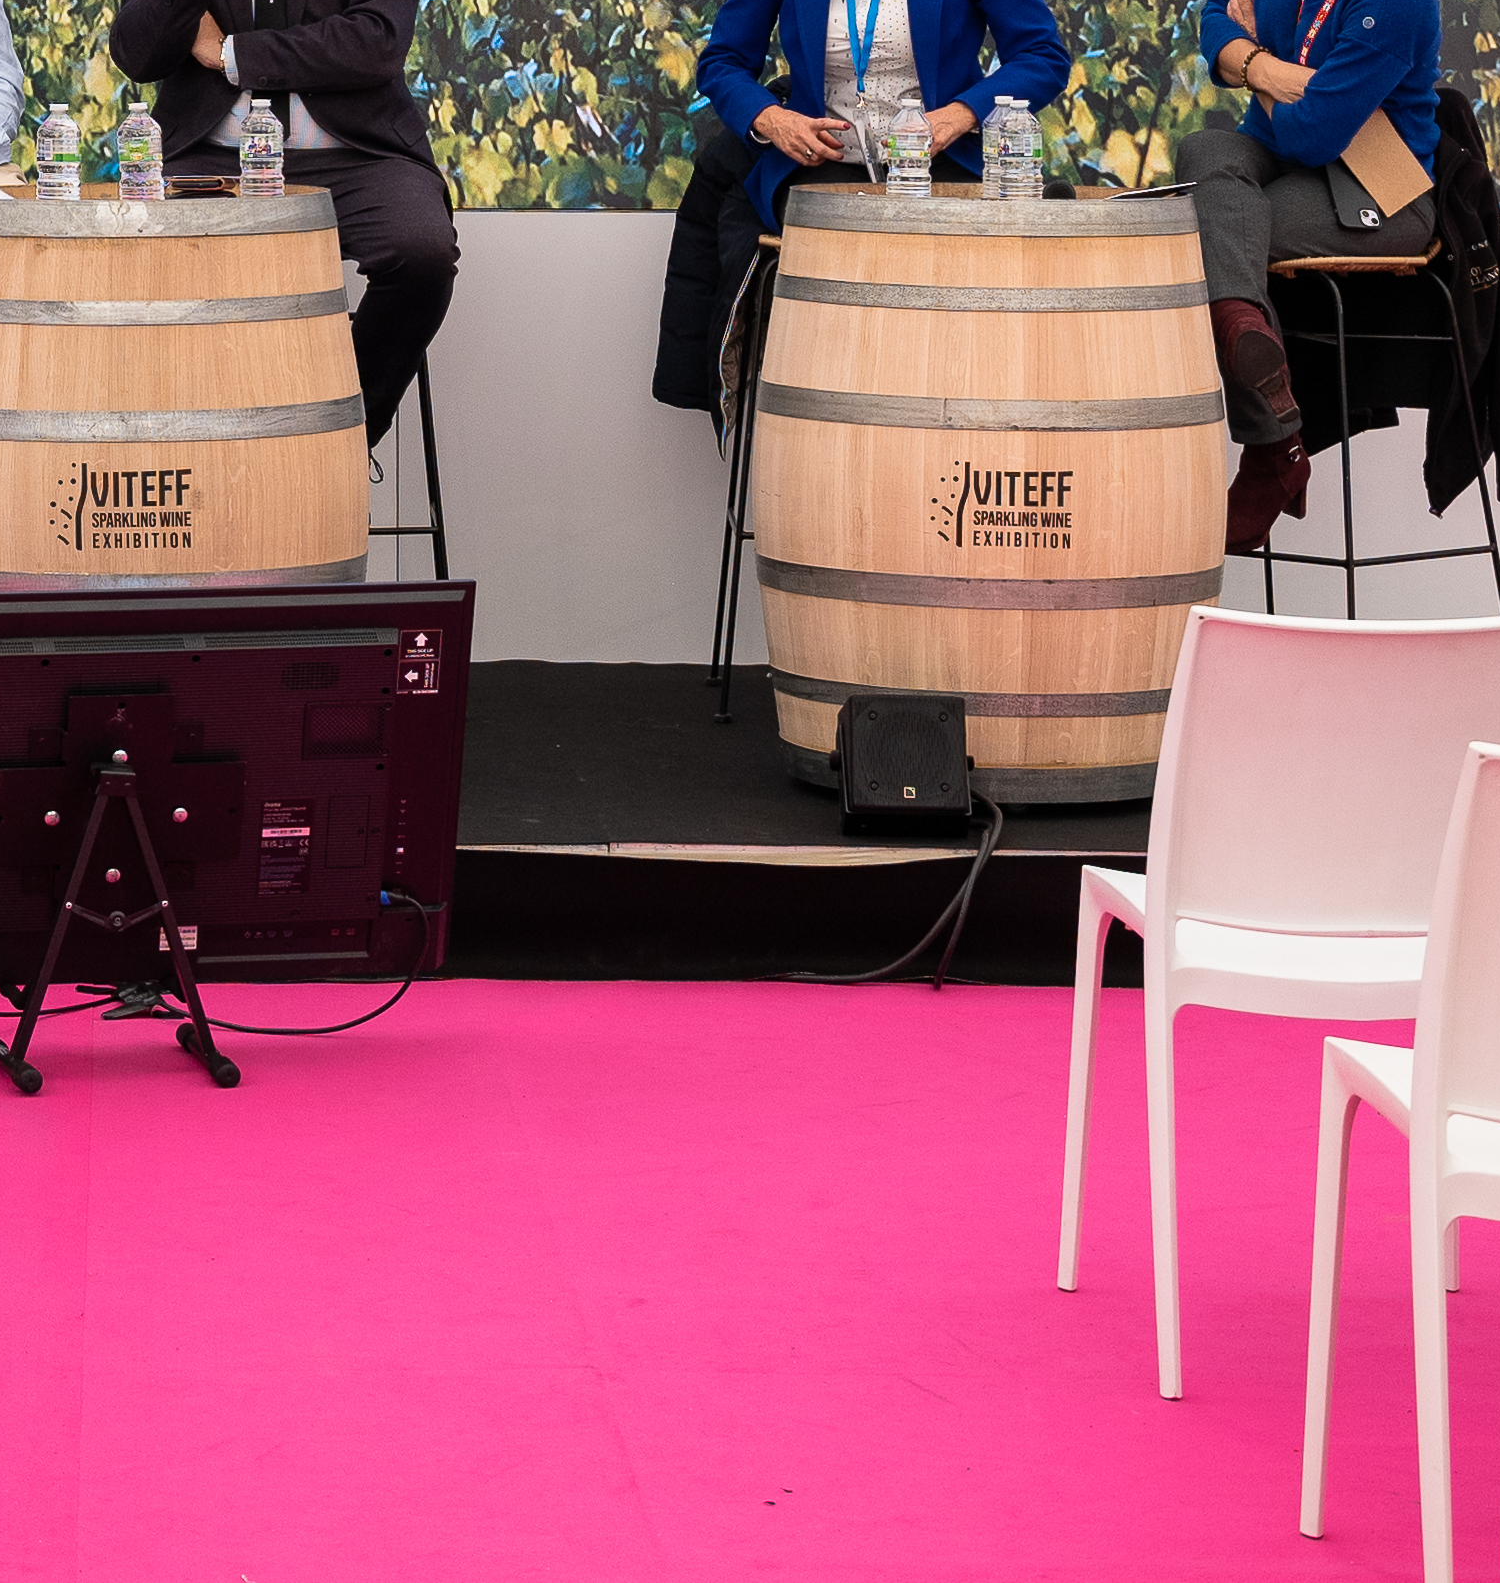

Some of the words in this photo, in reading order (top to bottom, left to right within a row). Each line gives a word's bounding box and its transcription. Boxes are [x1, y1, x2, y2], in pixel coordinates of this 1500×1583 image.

[91, 469, 191, 507] VITEFF
[974, 471, 1073, 507] VITEFF
[92, 512, 156, 528] SPARKLING
[159, 511, 191, 527] WINE
[973, 510, 1037, 527] SPARKLING
[1041, 512, 1072, 528] WINE
[93, 532, 191, 548] EXHIBITION
[973, 531, 1070, 549] EXHIBITION
